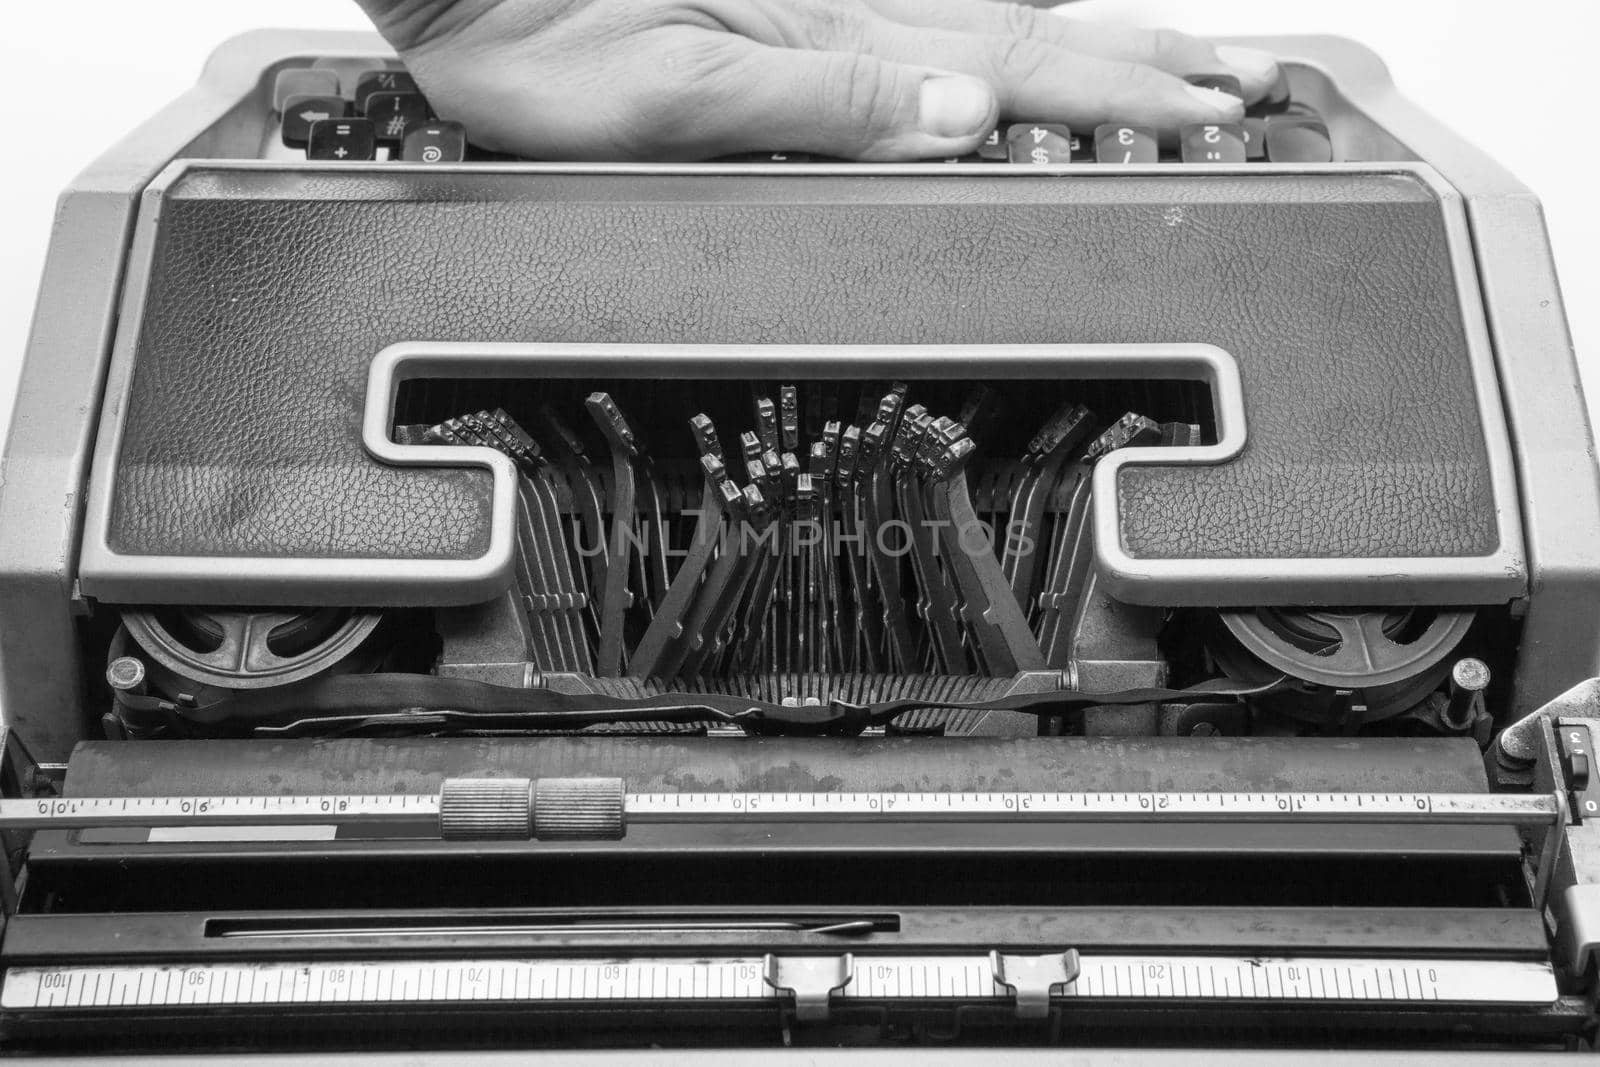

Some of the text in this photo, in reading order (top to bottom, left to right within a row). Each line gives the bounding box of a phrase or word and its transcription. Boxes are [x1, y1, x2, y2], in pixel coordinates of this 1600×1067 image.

[386, 115, 406, 136] #
[1203, 125, 1221, 143] 2
[985, 130, 999, 145] F
[1030, 126, 1049, 144] 4
[1118, 128, 1134, 145] 3
[422, 145, 443, 163] @
[1030, 147, 1049, 164] $
[1569, 732, 1582, 743] 3
[38, 798, 1426, 814] 0 10 20 30 40 50 80 90 100
[43, 964, 1437, 989] 0 10 20 40 50 60 70 80 90 100
